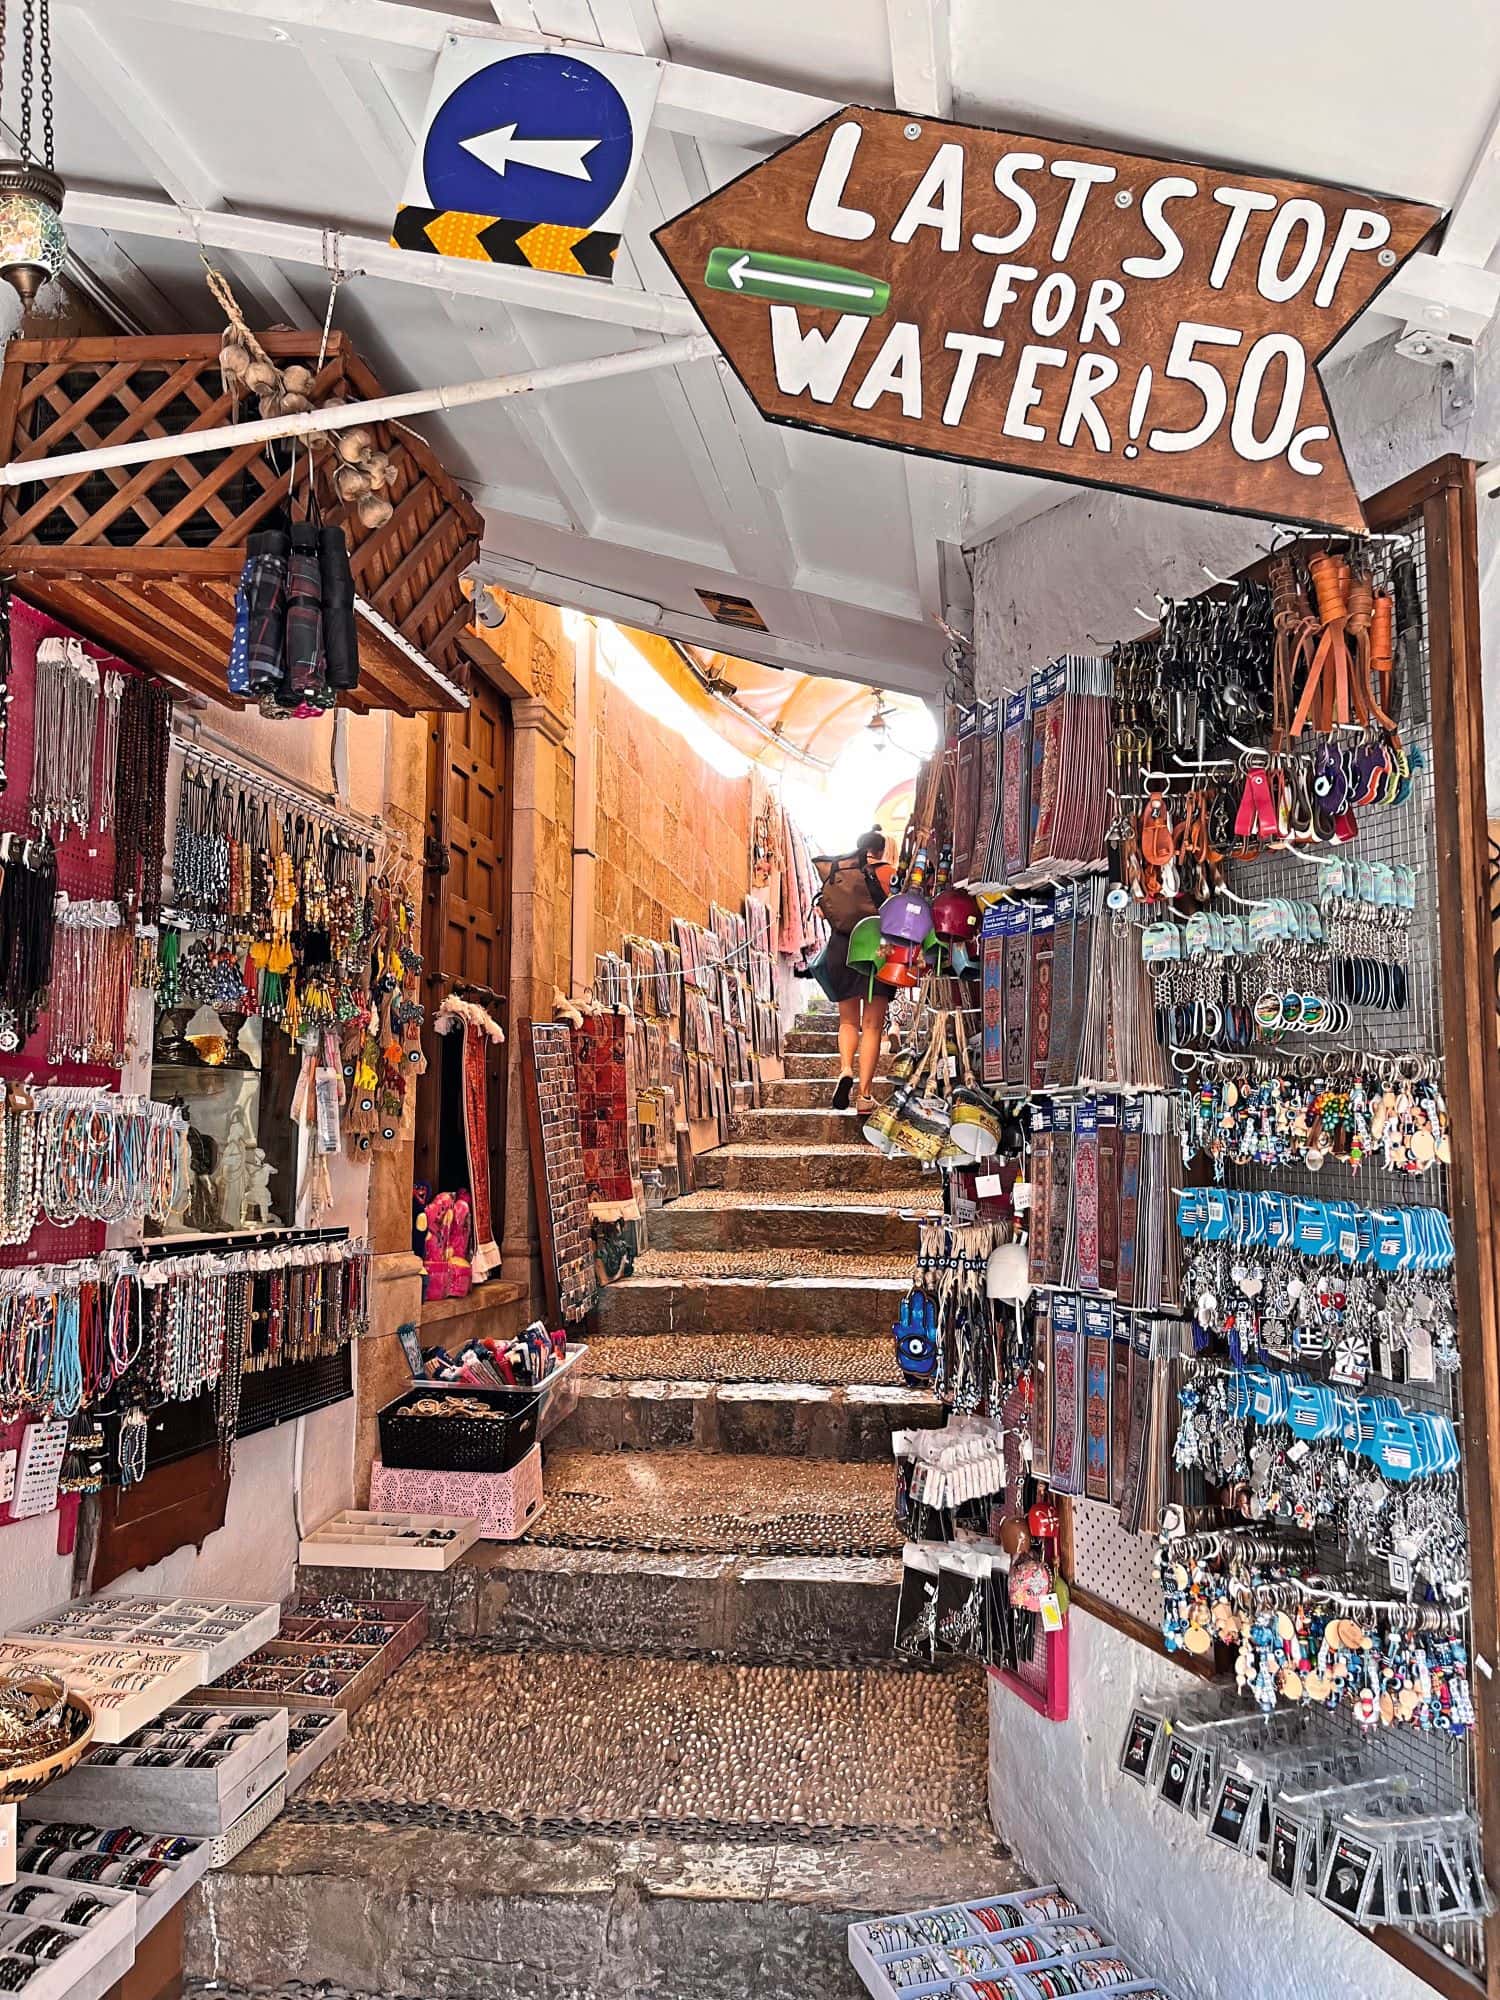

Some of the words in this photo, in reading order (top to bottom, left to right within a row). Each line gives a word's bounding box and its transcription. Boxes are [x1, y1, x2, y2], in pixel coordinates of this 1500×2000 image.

[806, 121, 1116, 262] LAST
[1122, 177, 1391, 308] STOP
[770, 305, 1153, 459] WATER!
[983, 263, 1125, 347] FOR
